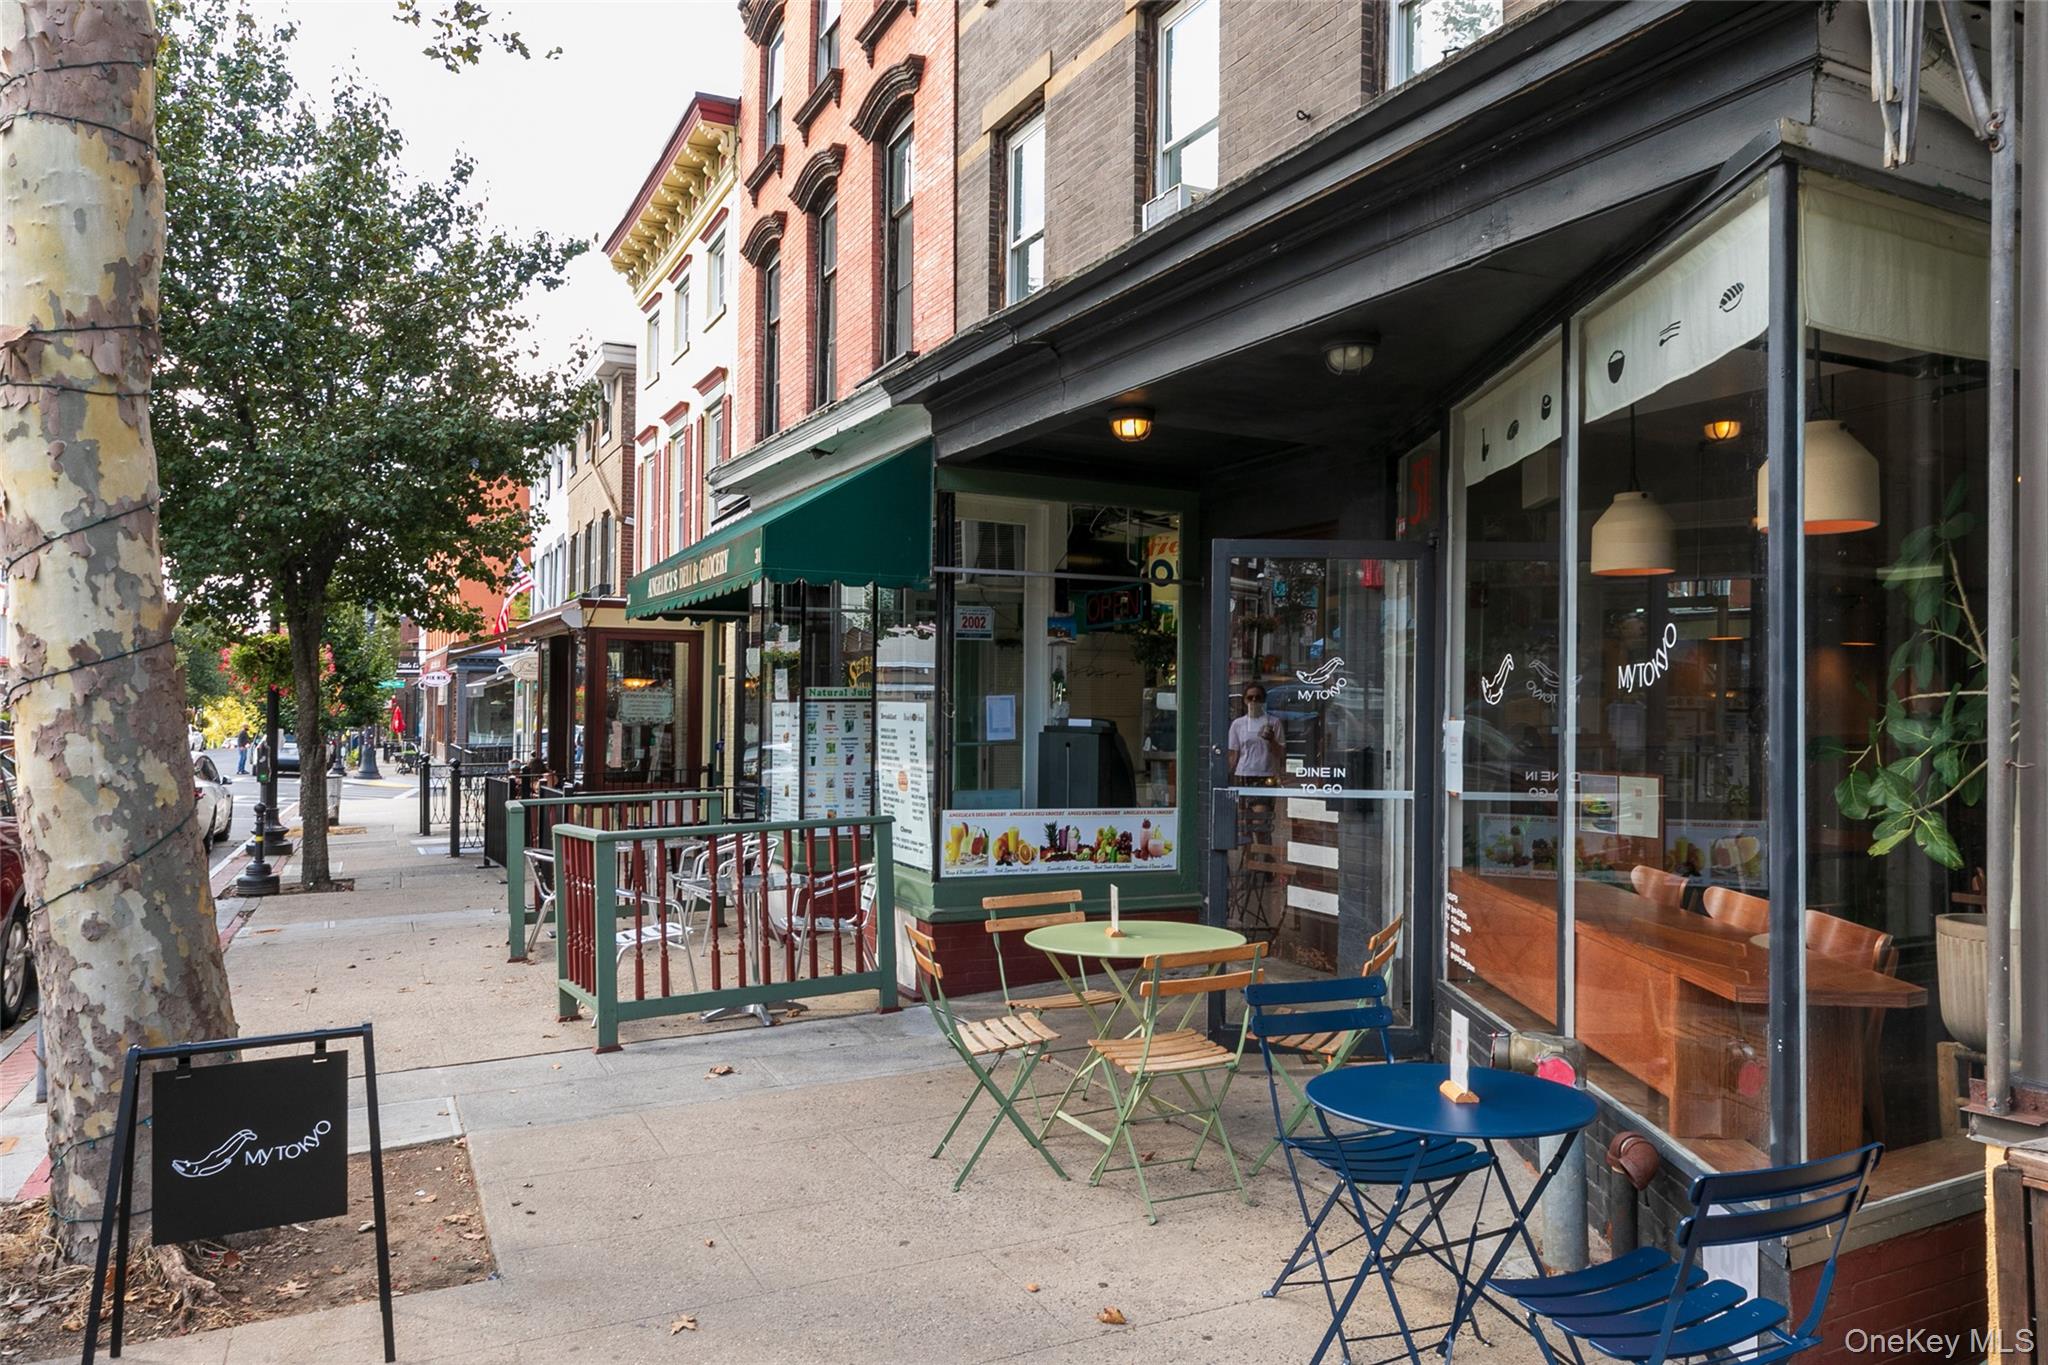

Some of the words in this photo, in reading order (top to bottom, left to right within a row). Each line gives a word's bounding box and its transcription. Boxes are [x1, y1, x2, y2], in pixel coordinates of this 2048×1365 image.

[647, 569, 678, 598] ANGELICA'S
[679, 562, 693, 589] DELI
[699, 549, 729, 582] GROCERY
[1088, 590, 1138, 621] OPEN
[961, 616, 986, 629] 2002
[809, 688, 847, 697] Natural
[1296, 767, 1331, 778] DINE
[1333, 767, 1346, 778] IN
[1300, 783, 1343, 794] TO-GO
[275, 1120, 331, 1161] TOKYO
